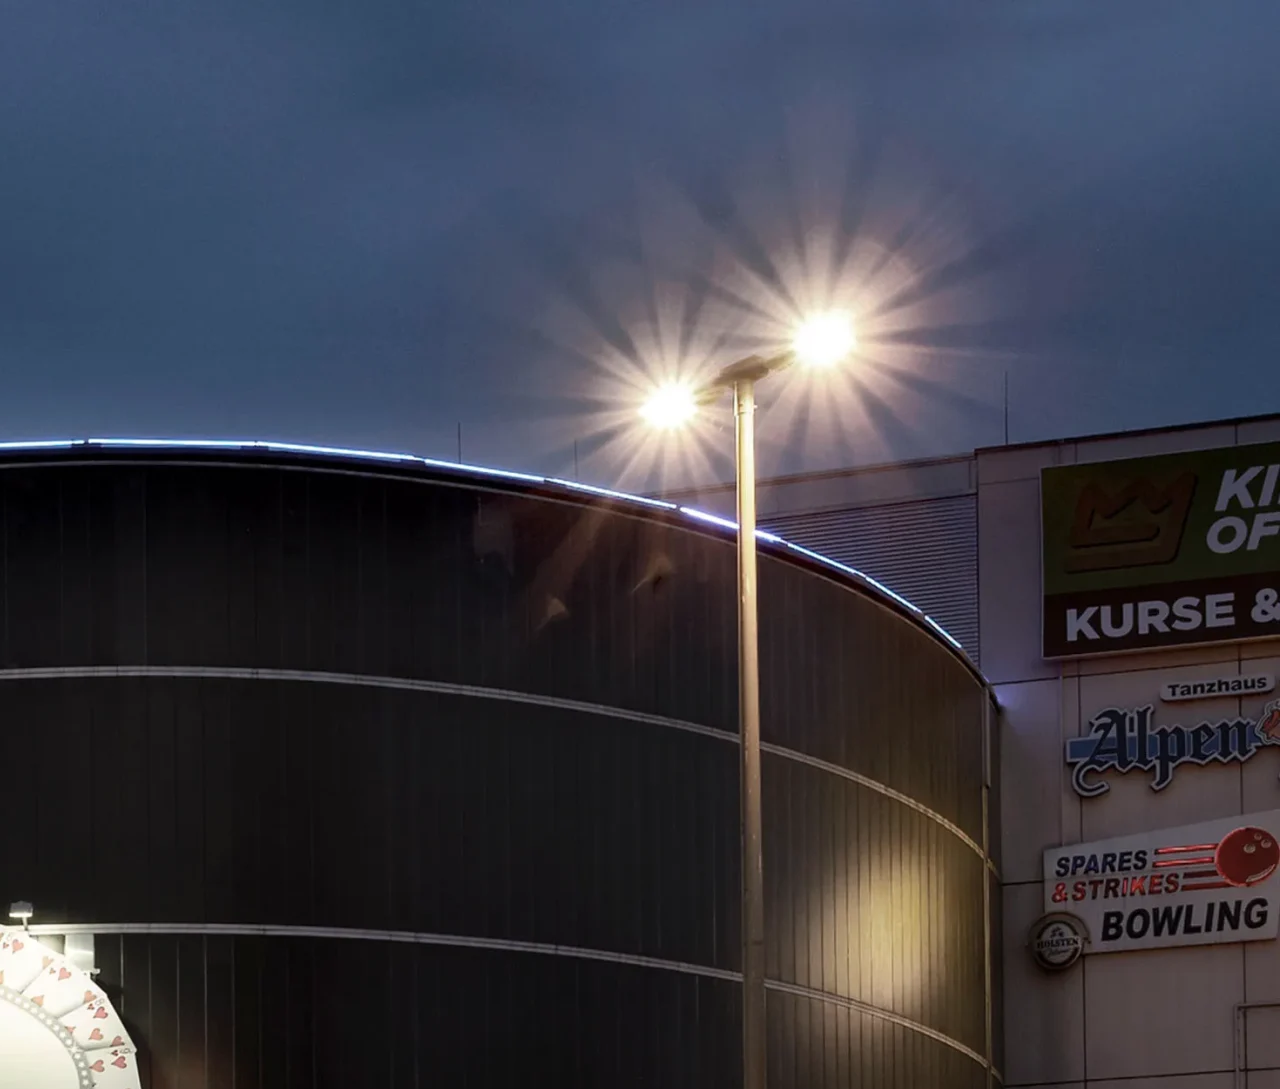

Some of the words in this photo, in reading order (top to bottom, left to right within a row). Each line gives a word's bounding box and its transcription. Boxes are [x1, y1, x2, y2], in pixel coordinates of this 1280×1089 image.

[1214, 463, 1280, 512] KI
[1066, 592, 1236, 642] KURSE
[1251, 587, 1280, 623] &
[1167, 676, 1268, 698] Tanzhaus
[1073, 704, 1258, 796] Alpen
[1055, 850, 1148, 878] SPARES
[1051, 882, 1069, 904] &
[1071, 872, 1180, 902] STRIKES
[1101, 897, 1269, 942] BOWLING
